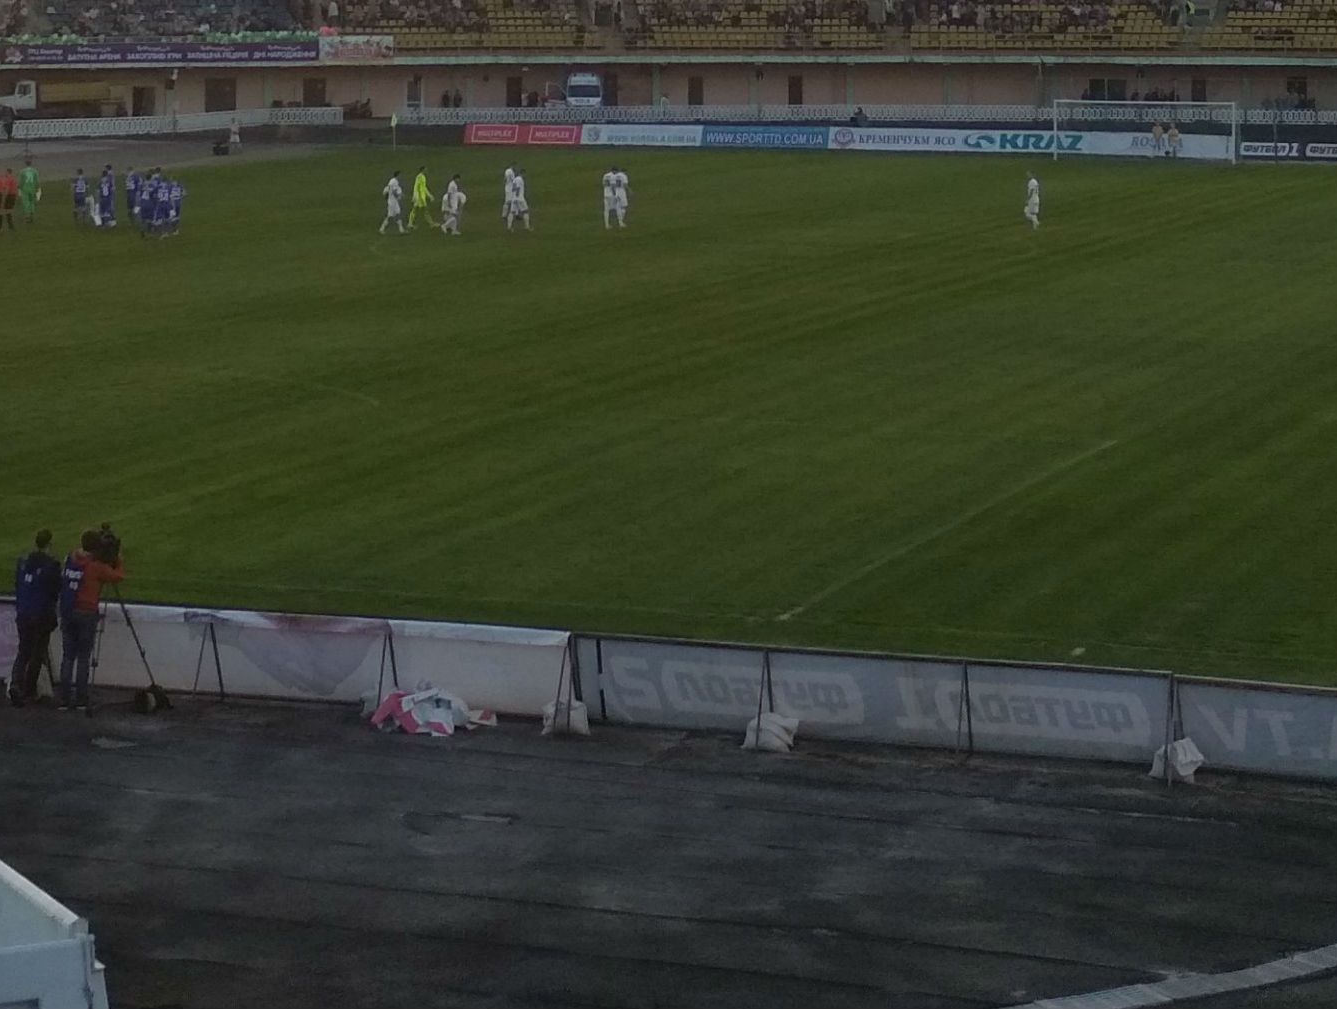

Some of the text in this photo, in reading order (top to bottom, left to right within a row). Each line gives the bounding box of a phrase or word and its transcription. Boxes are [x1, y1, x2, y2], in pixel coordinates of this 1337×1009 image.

[706, 131, 824, 146] WWW.SPORTTD.COM.UA
[999, 133, 1083, 151] KRAZ
[1243, 143, 1299, 157] ФУТБОЛ 1
